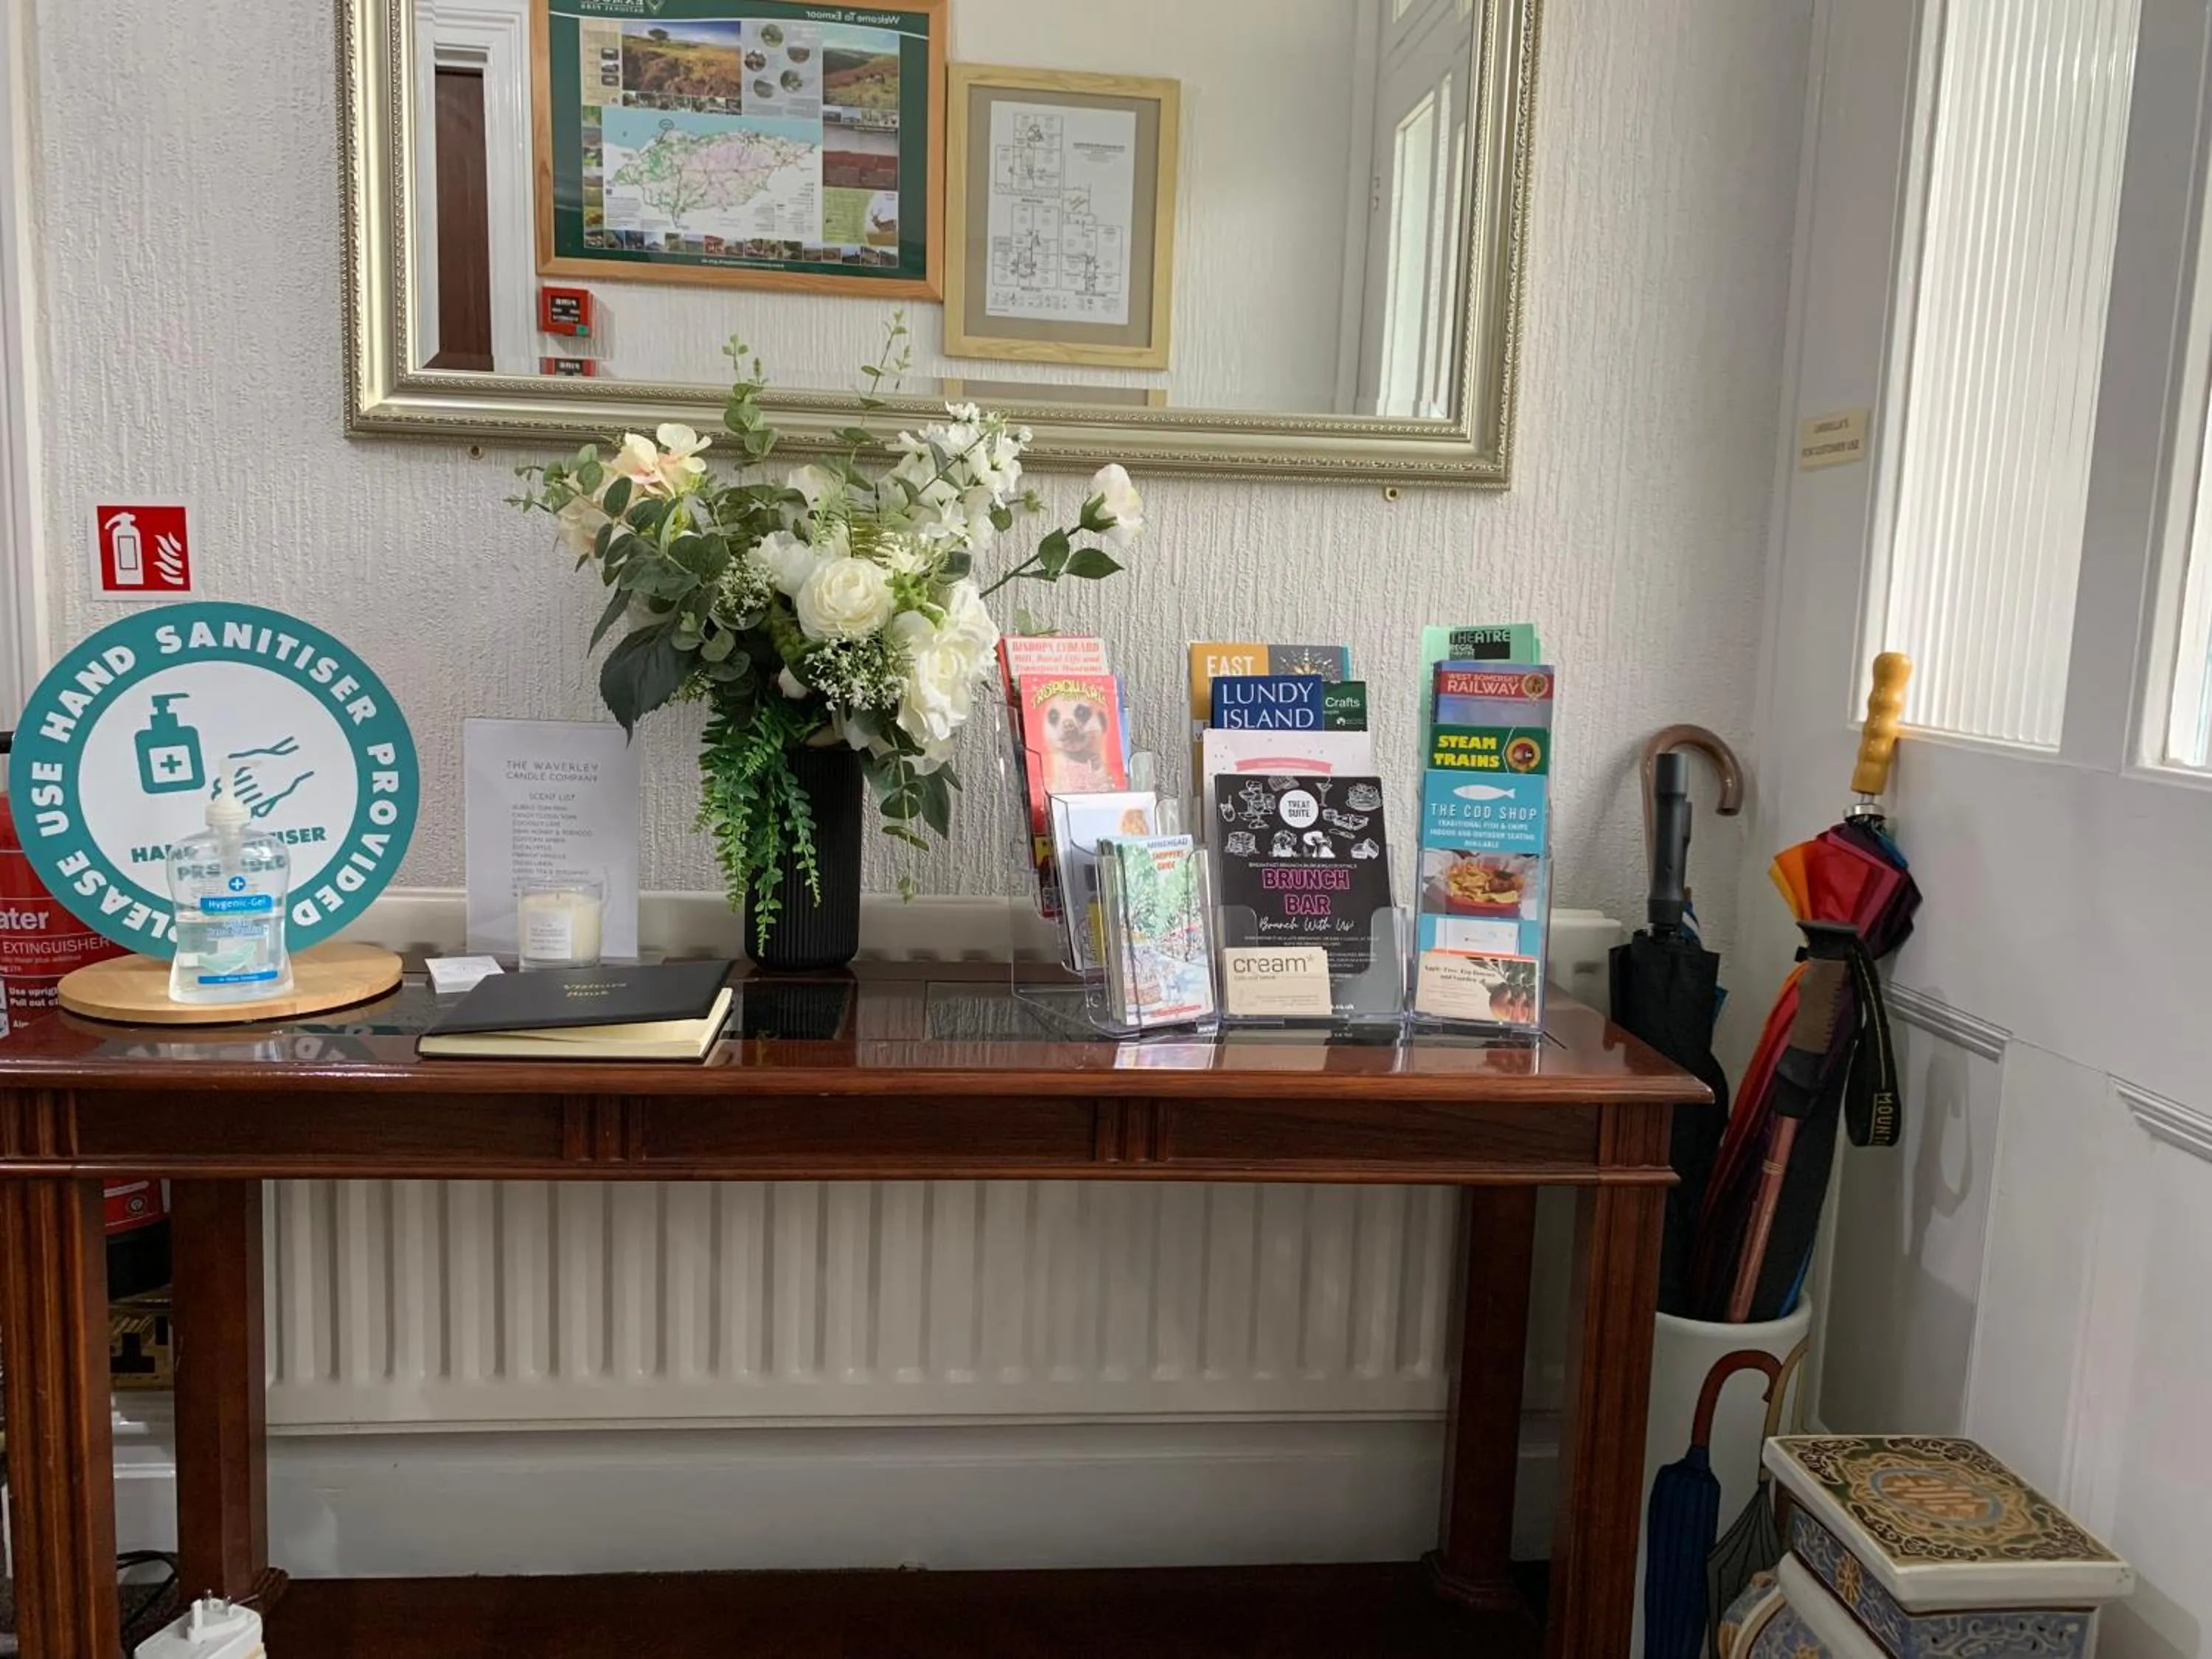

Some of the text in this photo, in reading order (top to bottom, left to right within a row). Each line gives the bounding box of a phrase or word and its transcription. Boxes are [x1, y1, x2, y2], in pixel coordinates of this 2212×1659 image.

[1450, 630, 1511, 644] THEATRE
[156, 621, 377, 726] SANITISER
[1207, 655, 1255, 677] EAST
[39, 645, 136, 743] HAND
[1222, 682, 1314, 704] LUNDY
[1447, 680, 1520, 695] RAILWAY
[1325, 697, 1360, 708] Crafts
[1223, 709, 1315, 729] ISLAND
[1439, 734, 1497, 750] STEAM
[507, 759, 599, 773] THE WAVERLEY
[1433, 753, 1500, 768] TRAINS
[31, 761, 69, 837] USE
[1287, 800, 1310, 808] TREAT
[1287, 809, 1311, 818] SUITE
[1430, 803, 1537, 821] THE COD SHOP
[292, 742, 400, 928] PROVIDED
[1147, 837, 1189, 848] MINEHEAD
[1262, 868, 1351, 890] BRUNCH
[1284, 894, 1332, 915] BAR
[0, 908, 49, 930] ater
[1259, 916, 1298, 931] Brunch
[1304, 917, 1332, 932] With
[1233, 956, 1307, 973] cream
[9, 987, 58, 998] Use uprig
[10, 998, 27, 1006] Pull
[29, 998, 45, 1006] out
